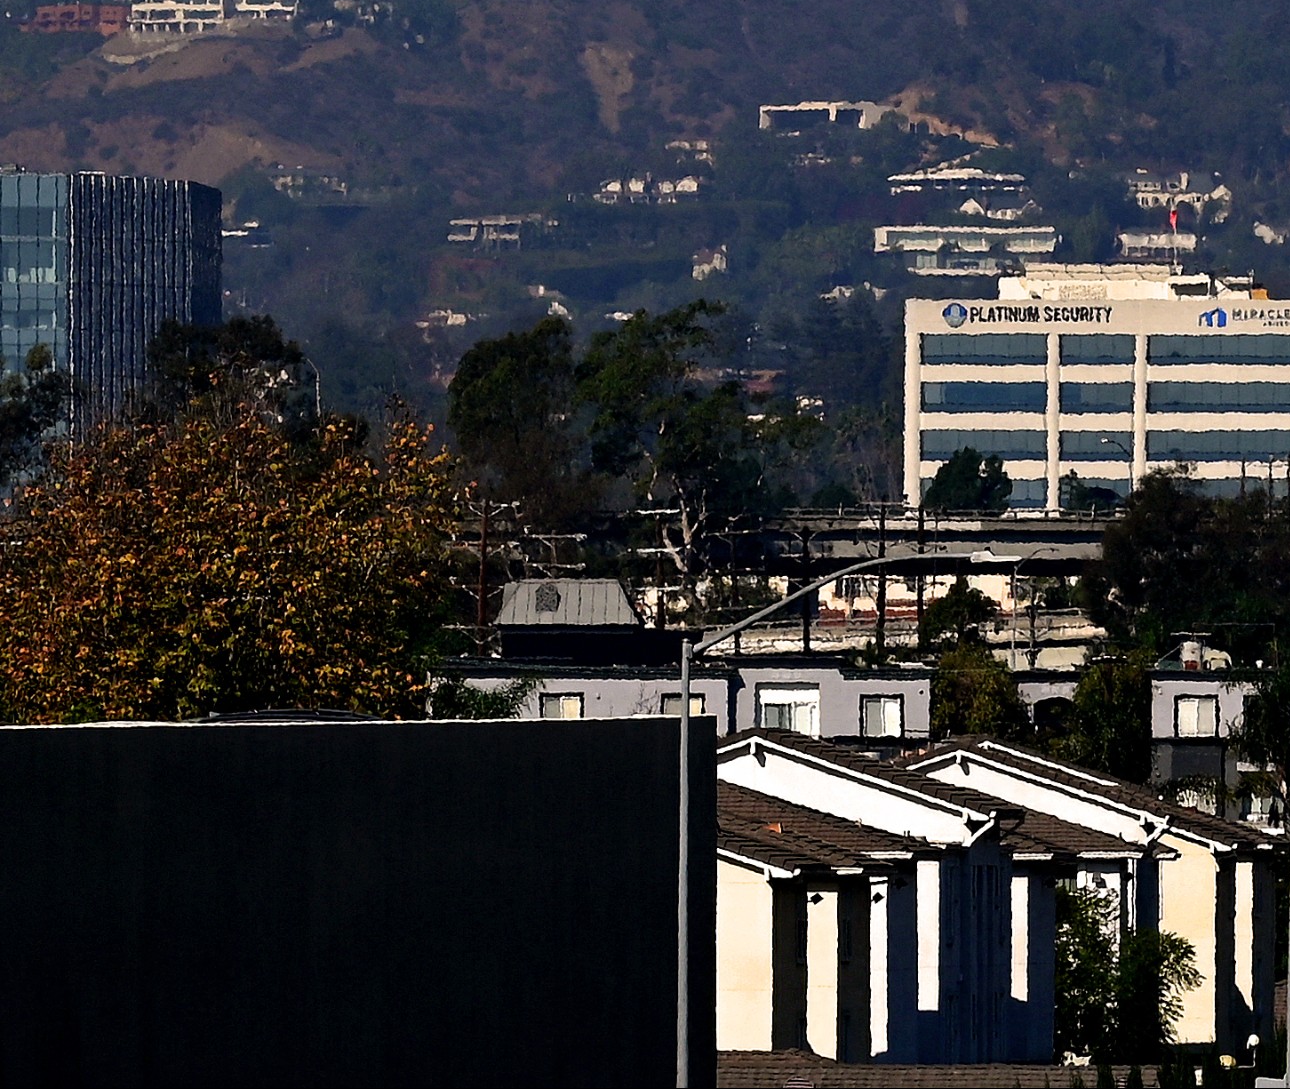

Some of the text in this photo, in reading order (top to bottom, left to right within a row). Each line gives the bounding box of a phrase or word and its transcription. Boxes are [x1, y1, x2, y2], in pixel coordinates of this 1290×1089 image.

[970, 306, 1113, 323] PLATINUM SECURITY
[1232, 308, 1290, 320] MIRACLE
